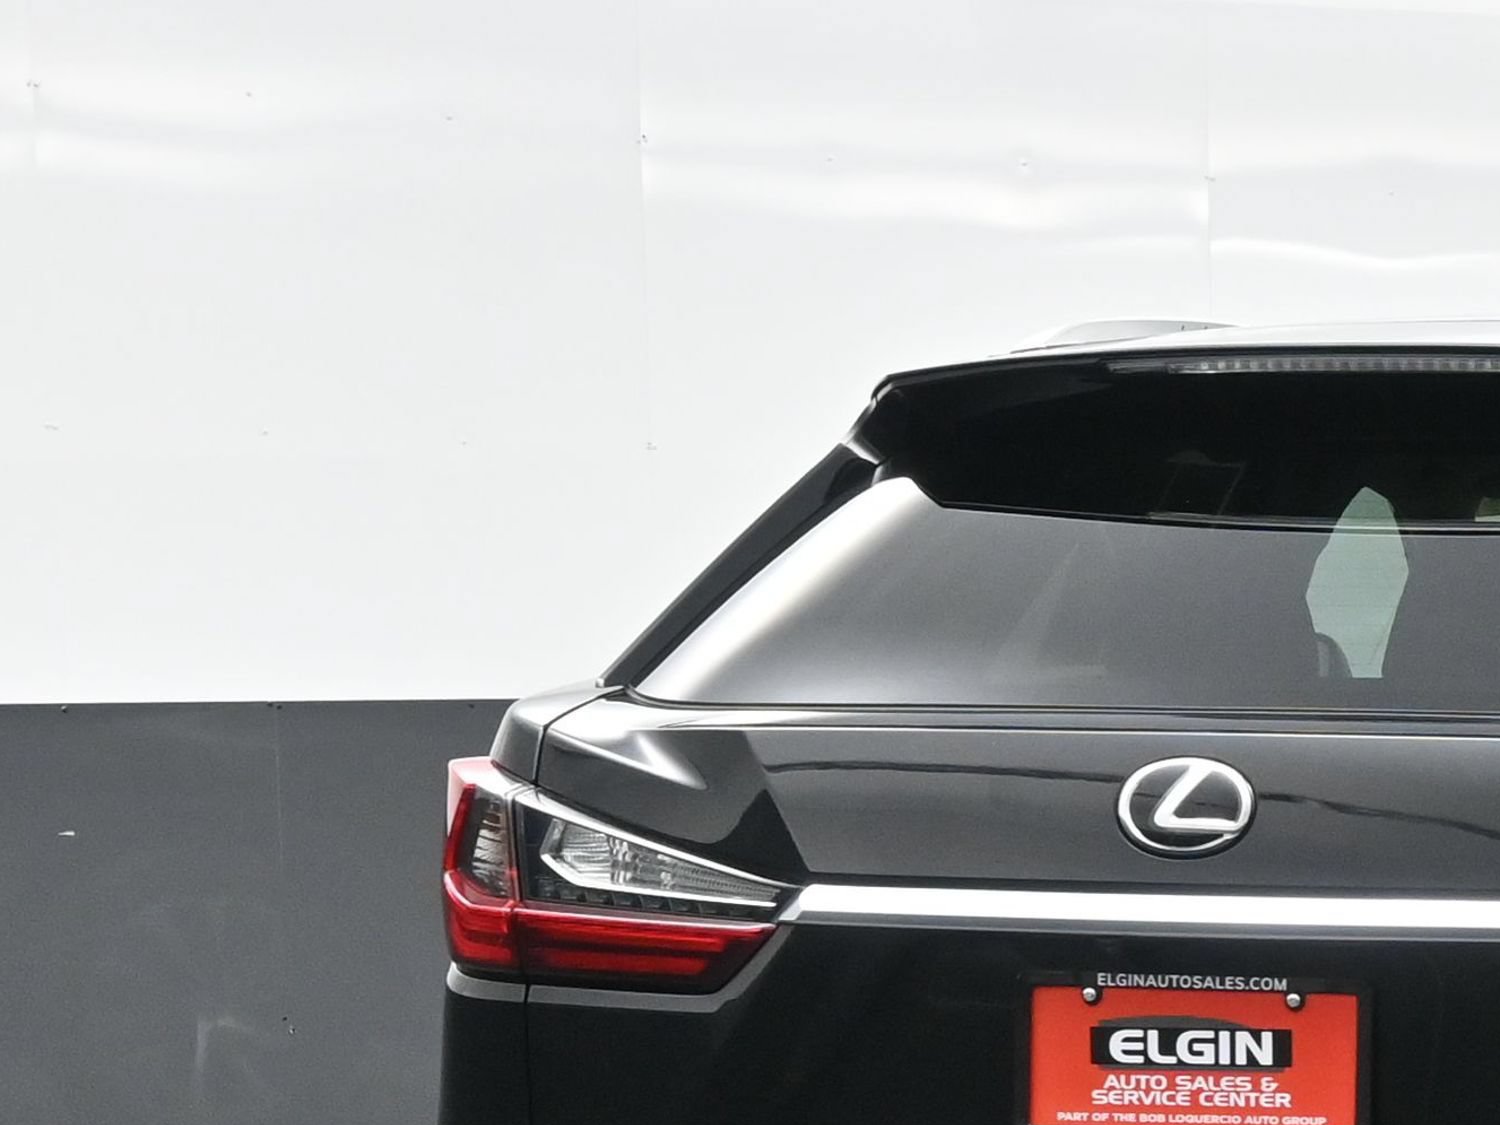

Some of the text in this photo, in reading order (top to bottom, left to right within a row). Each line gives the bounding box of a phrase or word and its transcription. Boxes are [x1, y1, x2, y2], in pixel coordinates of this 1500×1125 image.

[1097, 973, 1287, 991] ELGINAUTOSALES.COM
[1108, 1029, 1273, 1065] ELGIN
[1103, 1075, 1278, 1092] AUTO SALES &
[1091, 1090, 1292, 1108] SERVICE CENTER
[1057, 1112, 1327, 1125] PART OF THE BOB LOQUERCIO AUTO GROUP
